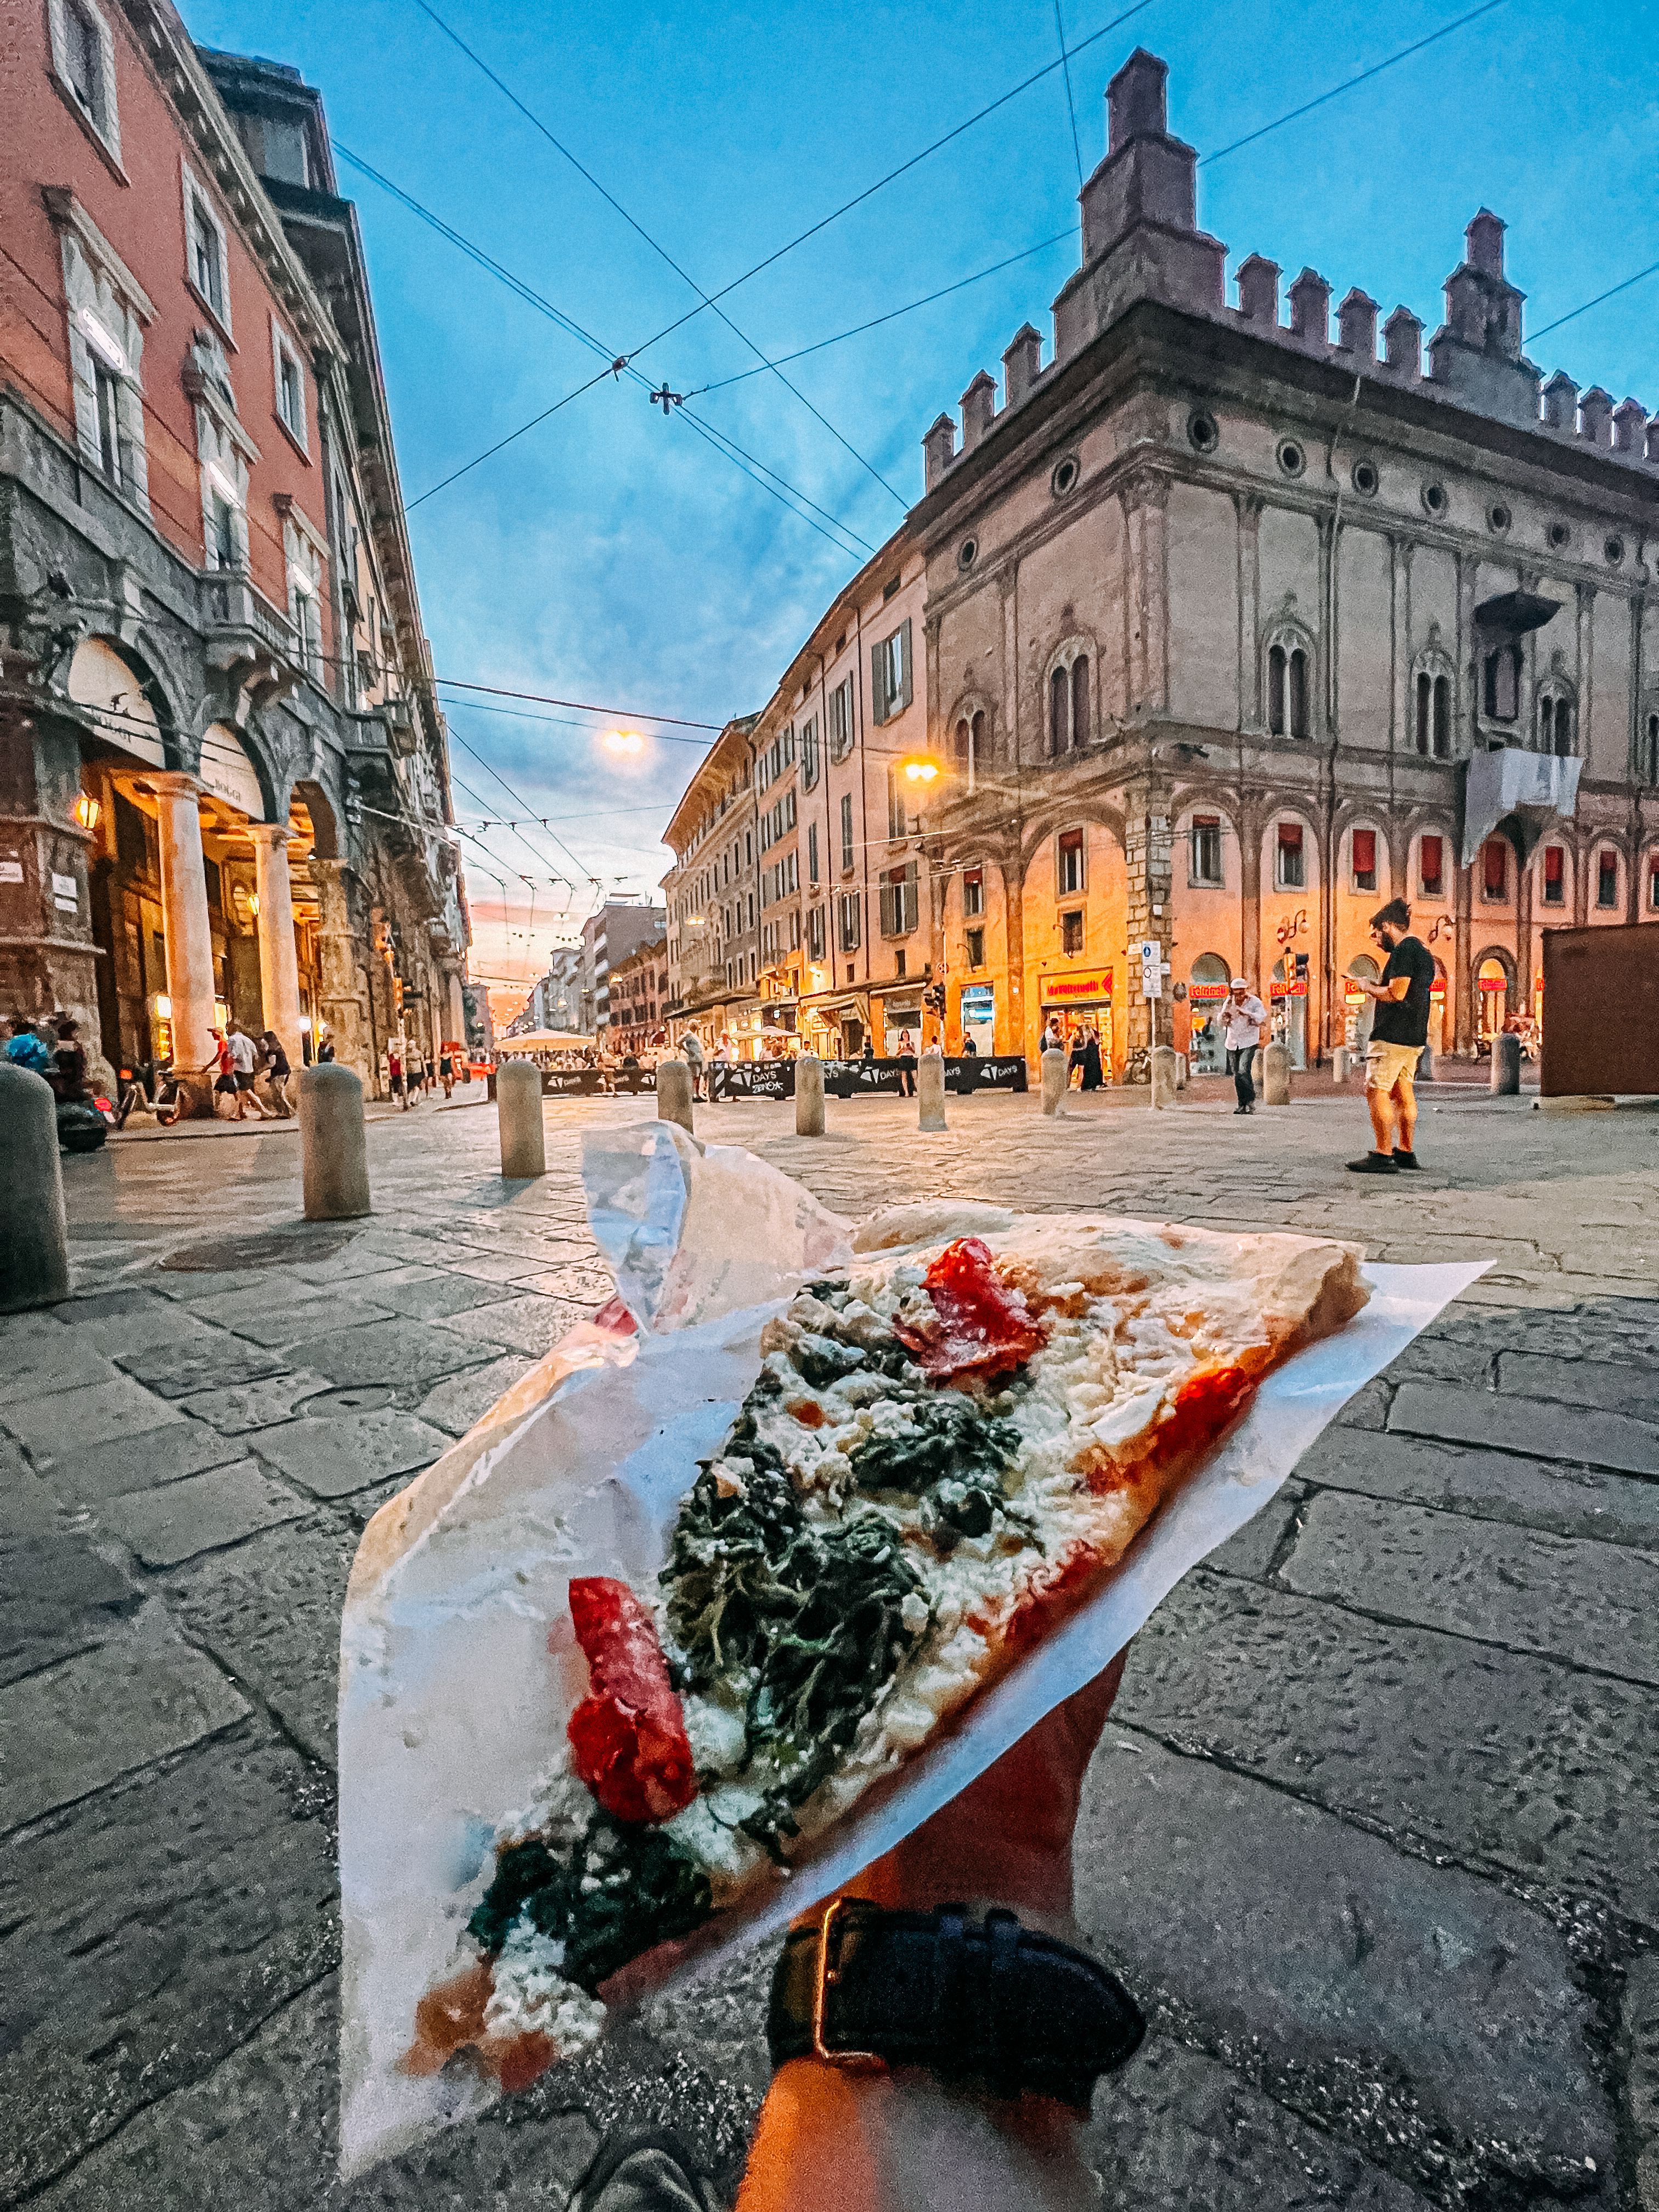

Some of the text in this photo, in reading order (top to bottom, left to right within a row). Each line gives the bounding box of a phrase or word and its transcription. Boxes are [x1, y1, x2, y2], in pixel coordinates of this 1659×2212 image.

[945, 1066, 961, 1076] AYS
[998, 1065, 1017, 1076] DAYS
[752, 1071, 777, 1083] DAYS
